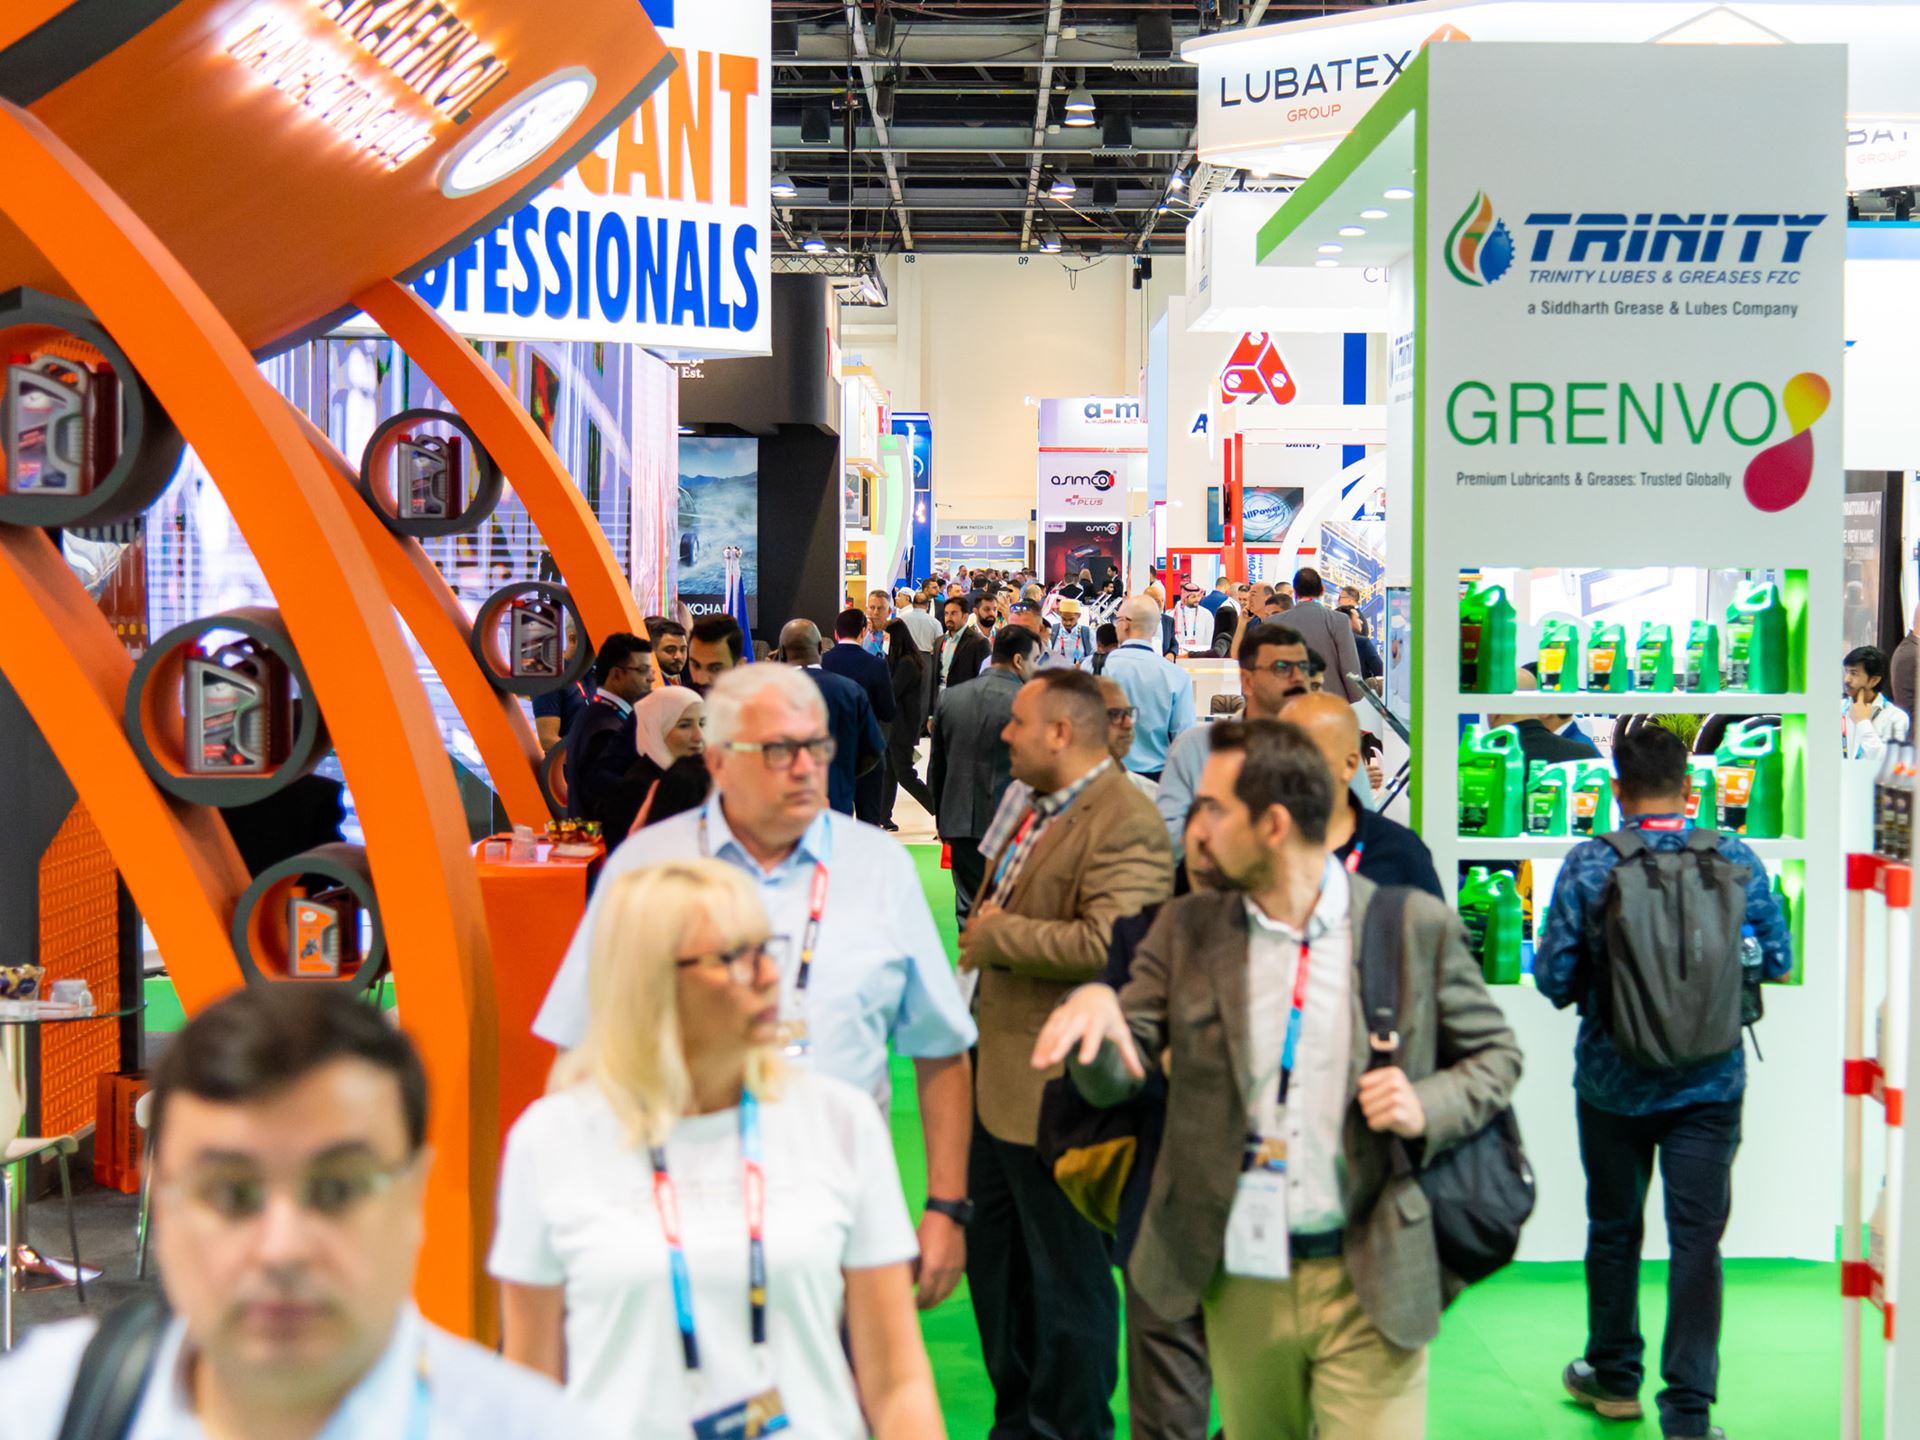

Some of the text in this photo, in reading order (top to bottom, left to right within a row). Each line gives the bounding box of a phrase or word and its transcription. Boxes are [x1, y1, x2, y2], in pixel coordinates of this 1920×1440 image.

[1221, 50, 1412, 107] LUBATEX
[1287, 103, 1342, 123] GROUP
[1524, 213, 1828, 263] TRINITY
[904, 255, 916, 264] 08
[1018, 257, 1029, 265] 09
[1529, 270, 1801, 284] TRINITY LUBES & GREASES FZC
[1528, 301, 1798, 318] a Siddharth Grease & Lubes Company
[682, 366, 704, 378] Est.
[1446, 381, 1777, 446] GRENVO
[1456, 472, 1731, 489] Premium Lubricants & Greases: Trusted Globally
